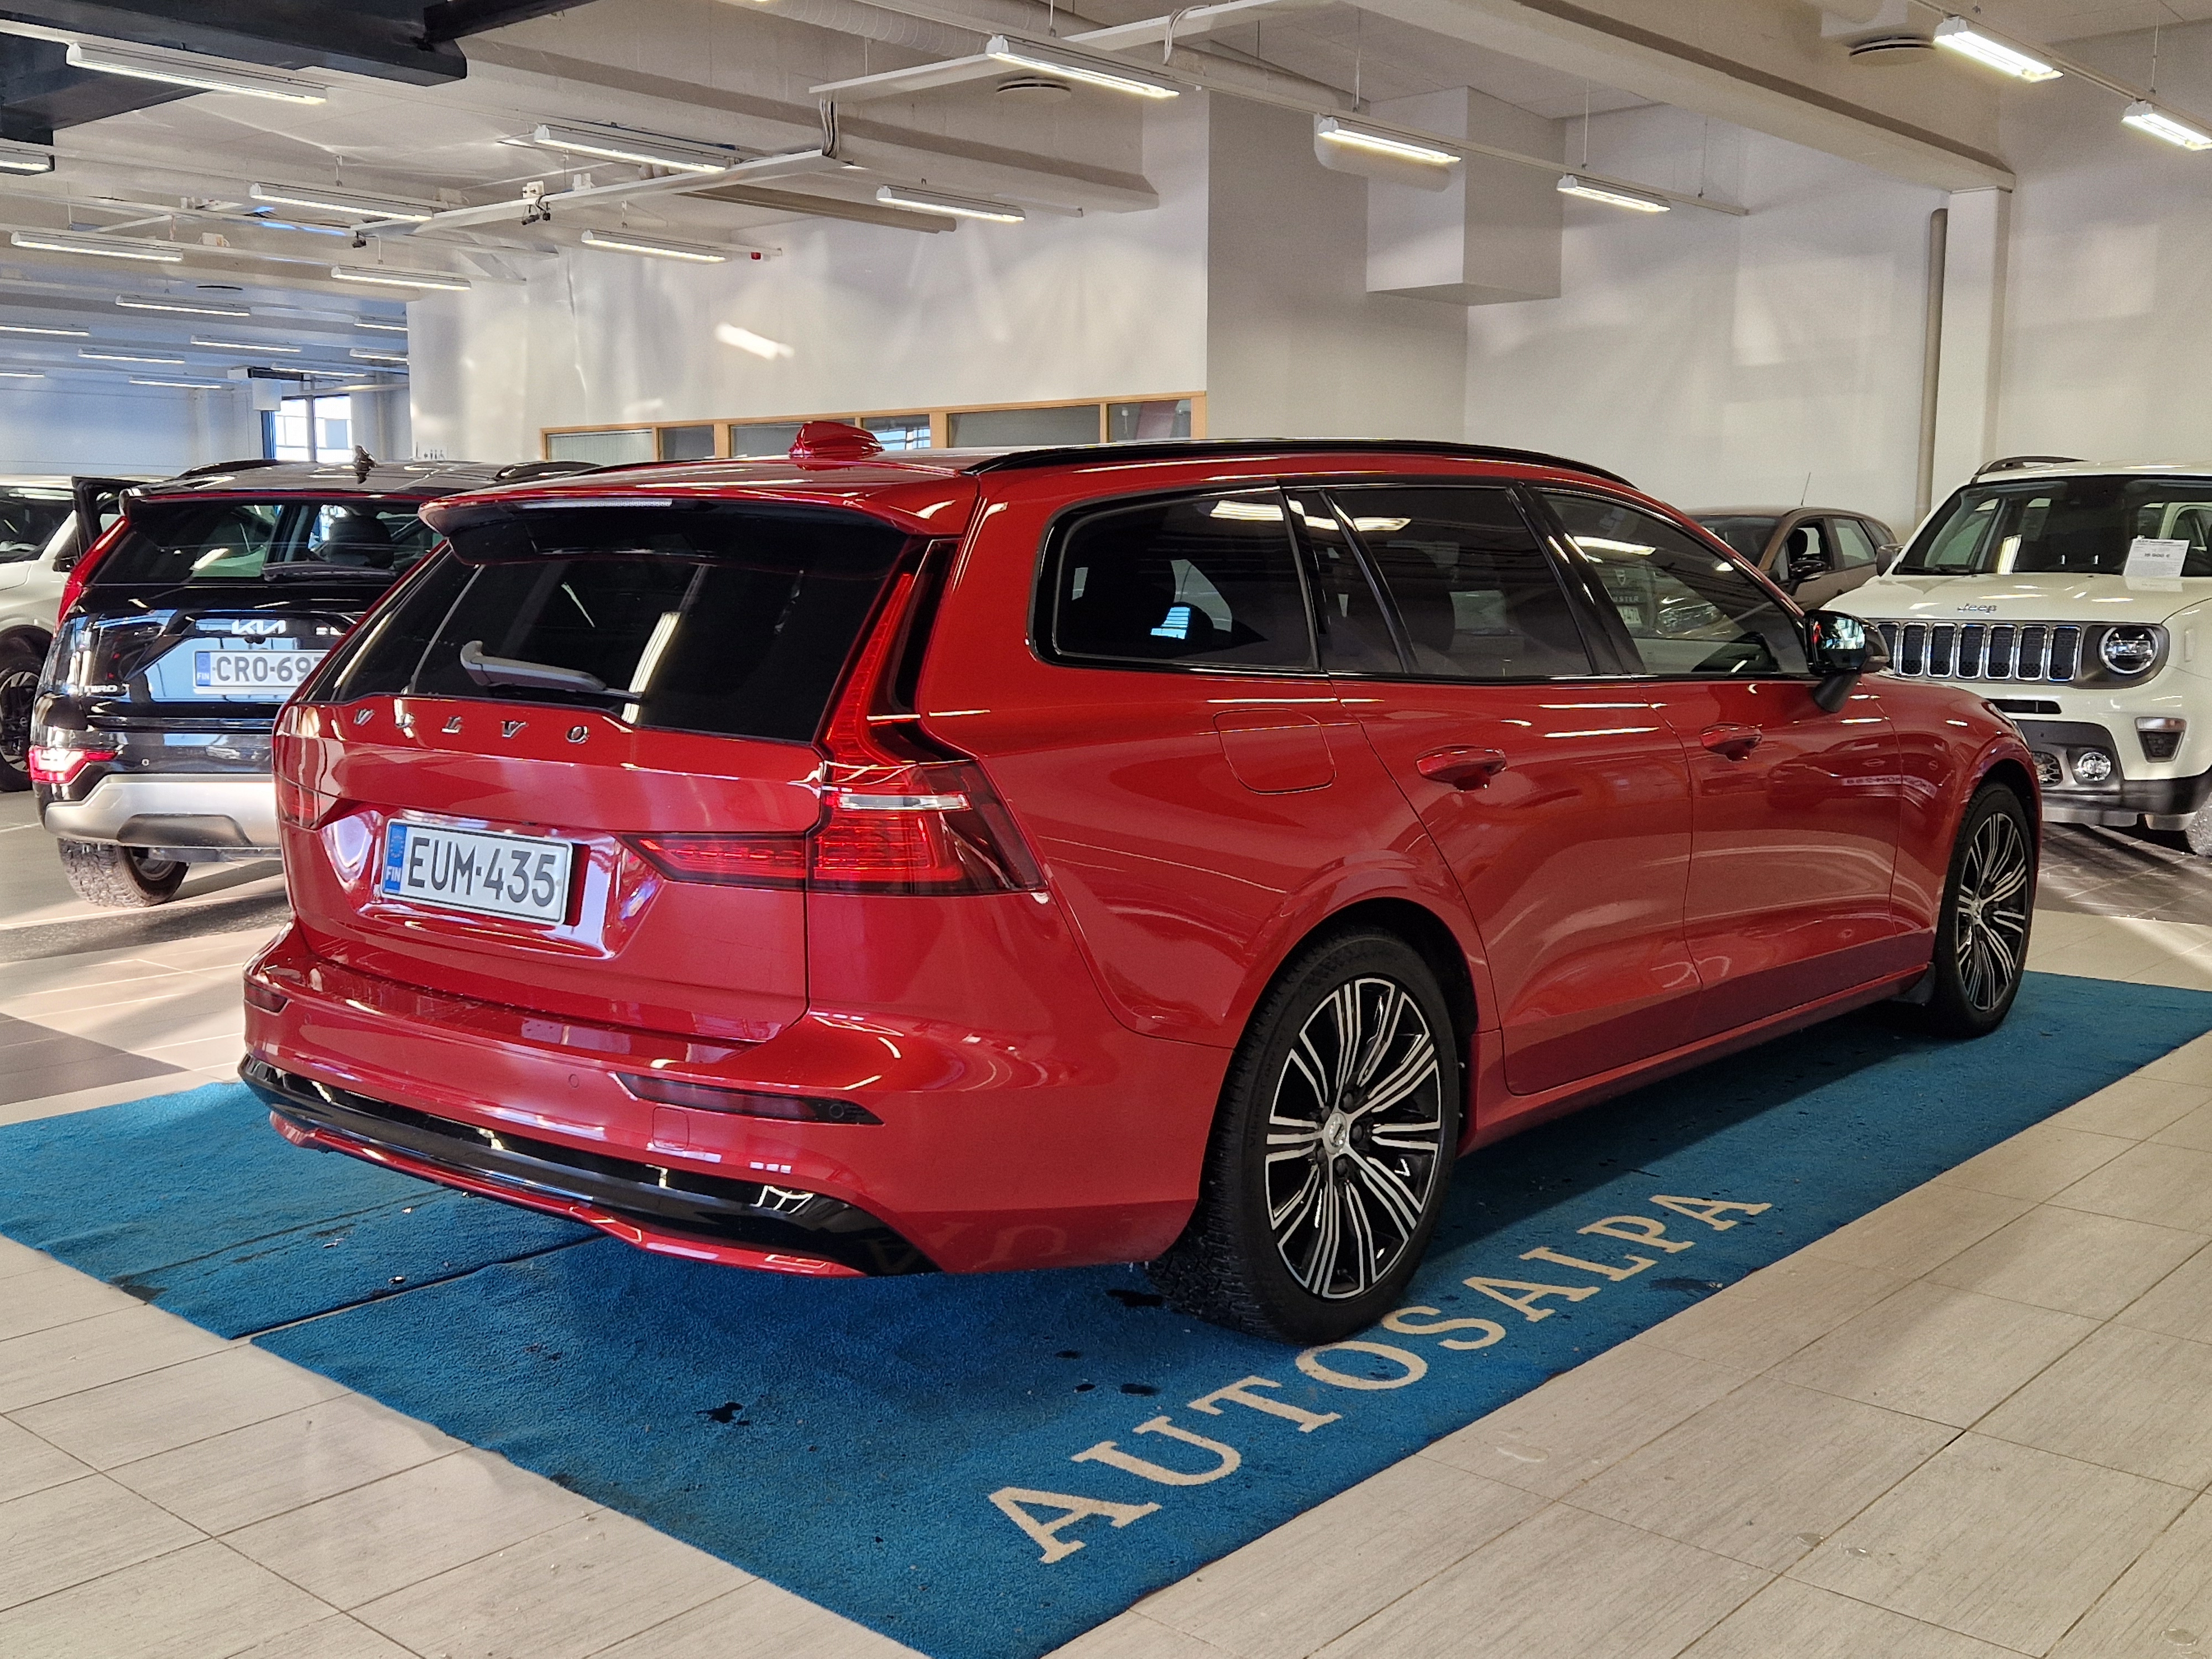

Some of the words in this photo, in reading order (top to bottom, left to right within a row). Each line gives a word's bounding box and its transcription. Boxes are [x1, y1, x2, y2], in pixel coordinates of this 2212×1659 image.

[1957, 603, 1997, 614] Jeep
[231, 620, 286, 634] KIA
[216, 656, 325, 682] CRO-69
[353, 708, 590, 744] VOLVO
[386, 865, 401, 882] FIN
[408, 836, 556, 907] EUM-435
[988, 1192, 1772, 1564] AUTOSALPA
